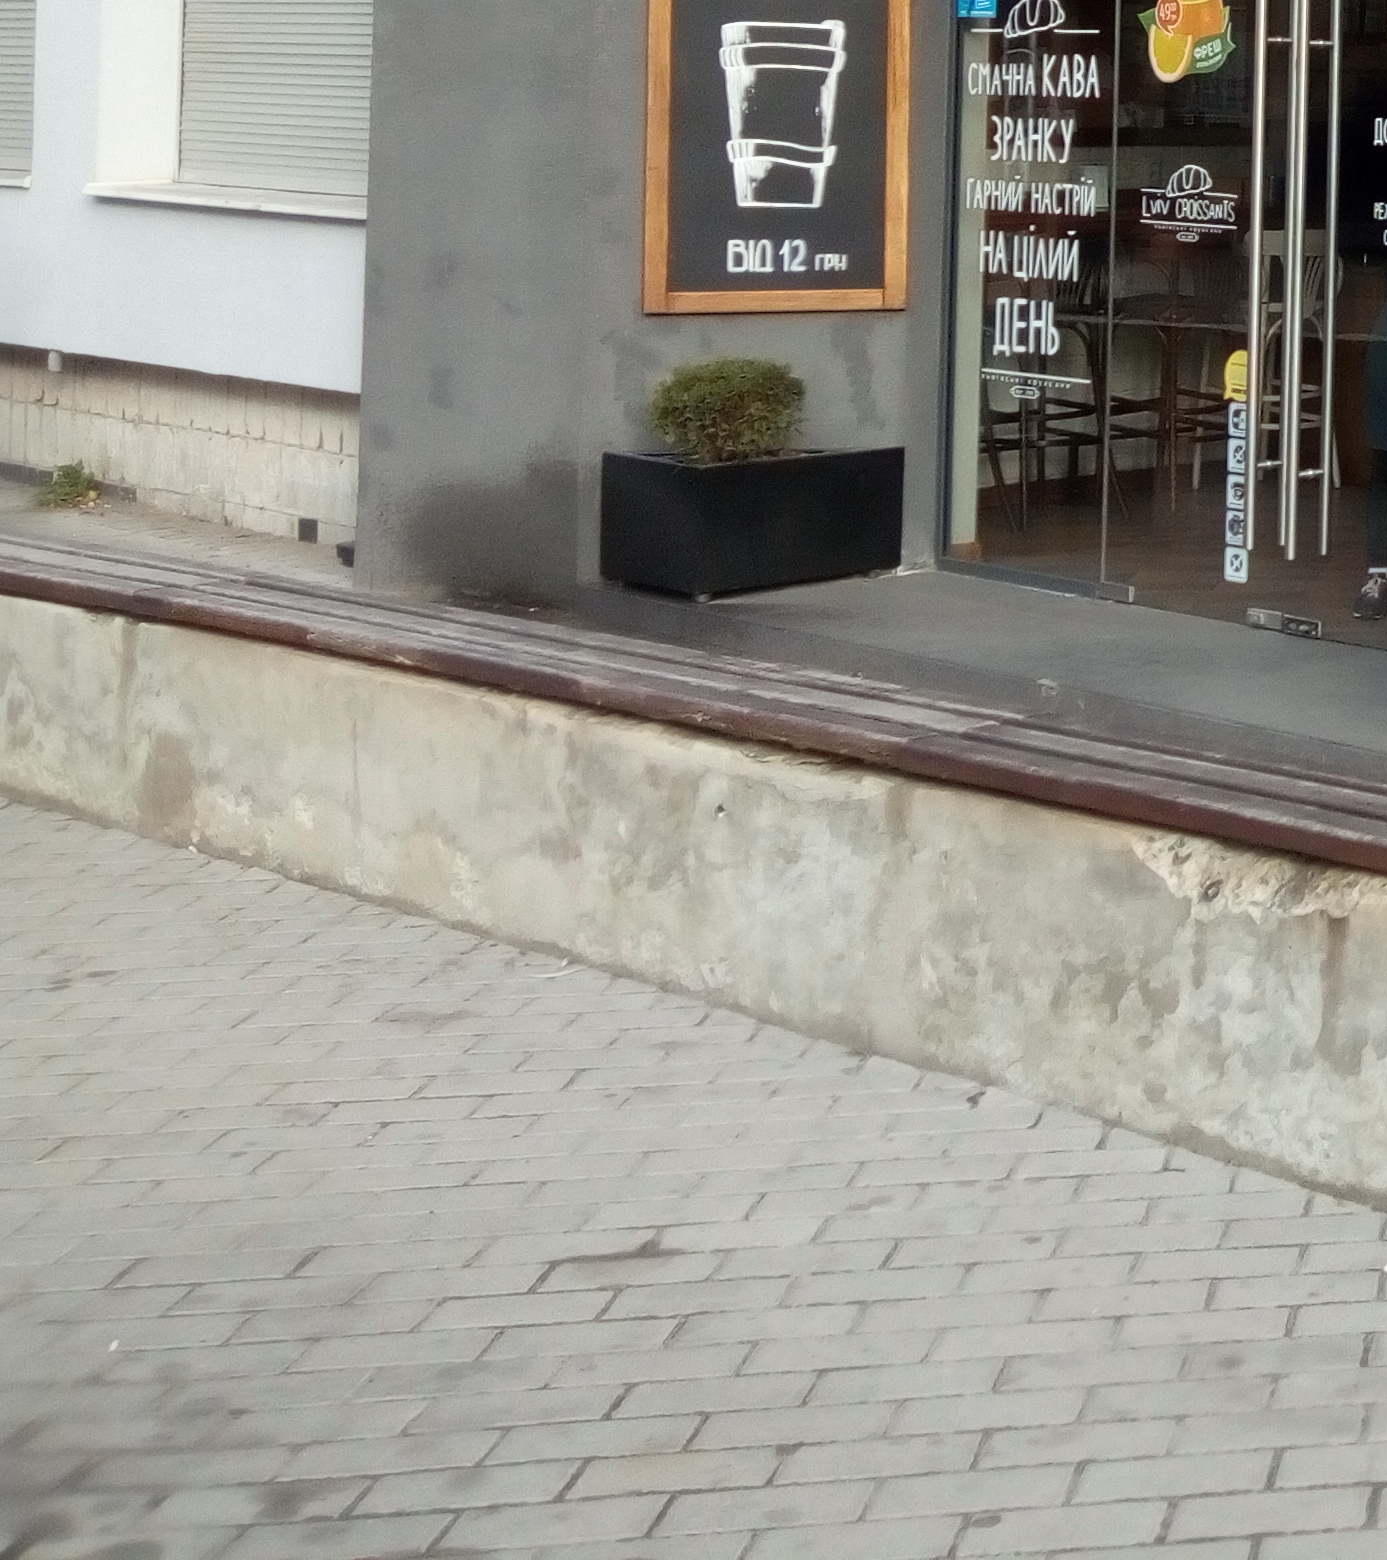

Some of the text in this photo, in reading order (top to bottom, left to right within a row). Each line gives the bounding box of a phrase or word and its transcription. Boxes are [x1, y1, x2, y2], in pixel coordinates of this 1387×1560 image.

[968, 53, 1100, 98] СМАЧНА КАВА
[990, 115, 1074, 164] ЗРАНКУ
[966, 175, 1097, 217] ГАРНИЙ НАСТРІЙ
[727, 239, 774, 273] ВІД
[779, 239, 807, 273] 12
[979, 224, 1079, 282] НА ЦІЛИЙ
[993, 297, 1060, 356] ДЕНЬ
